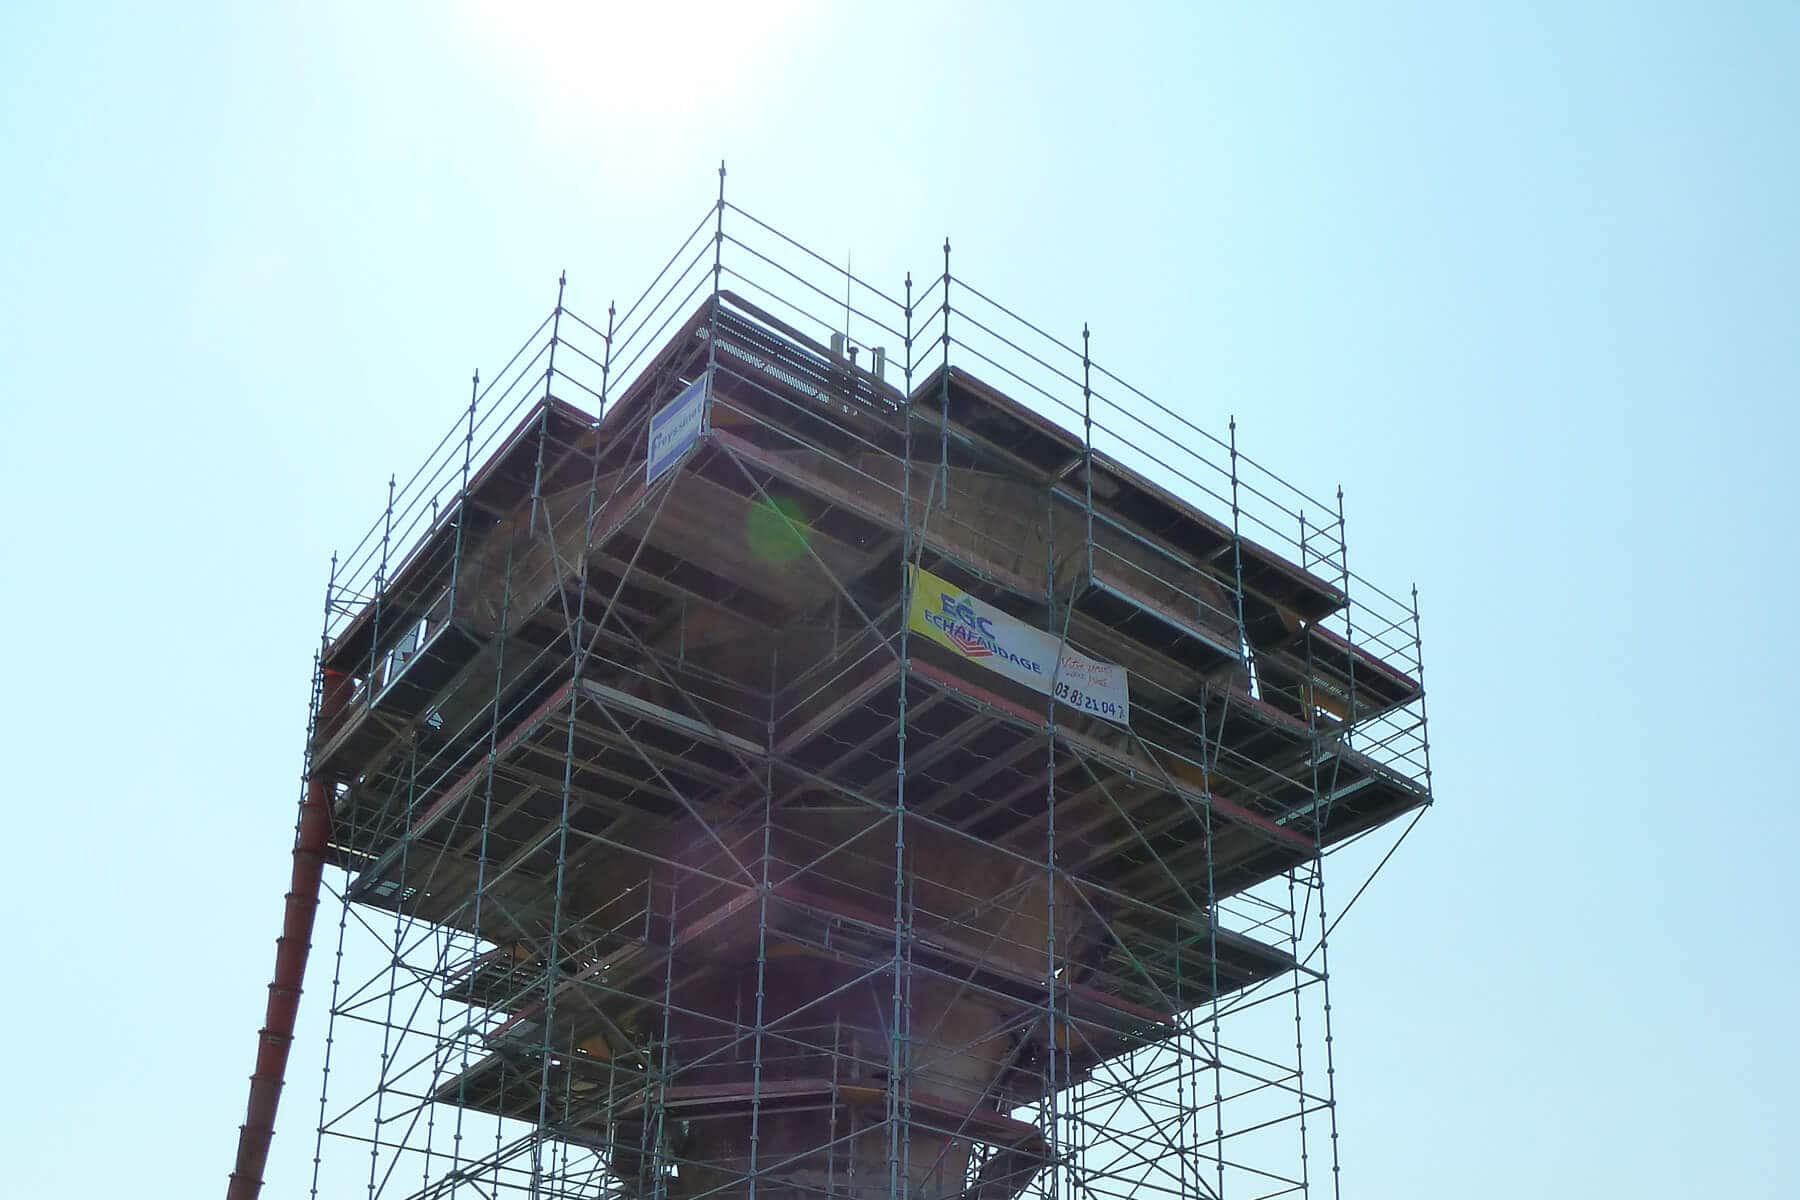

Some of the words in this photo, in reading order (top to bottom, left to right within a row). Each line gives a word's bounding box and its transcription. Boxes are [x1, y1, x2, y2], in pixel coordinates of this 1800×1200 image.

[924, 609, 1042, 674] ECHAFAUDAGE
[1055, 682, 1070, 699] 03
[1070, 689, 1084, 707] 83
[1085, 696, 1099, 711] 21
